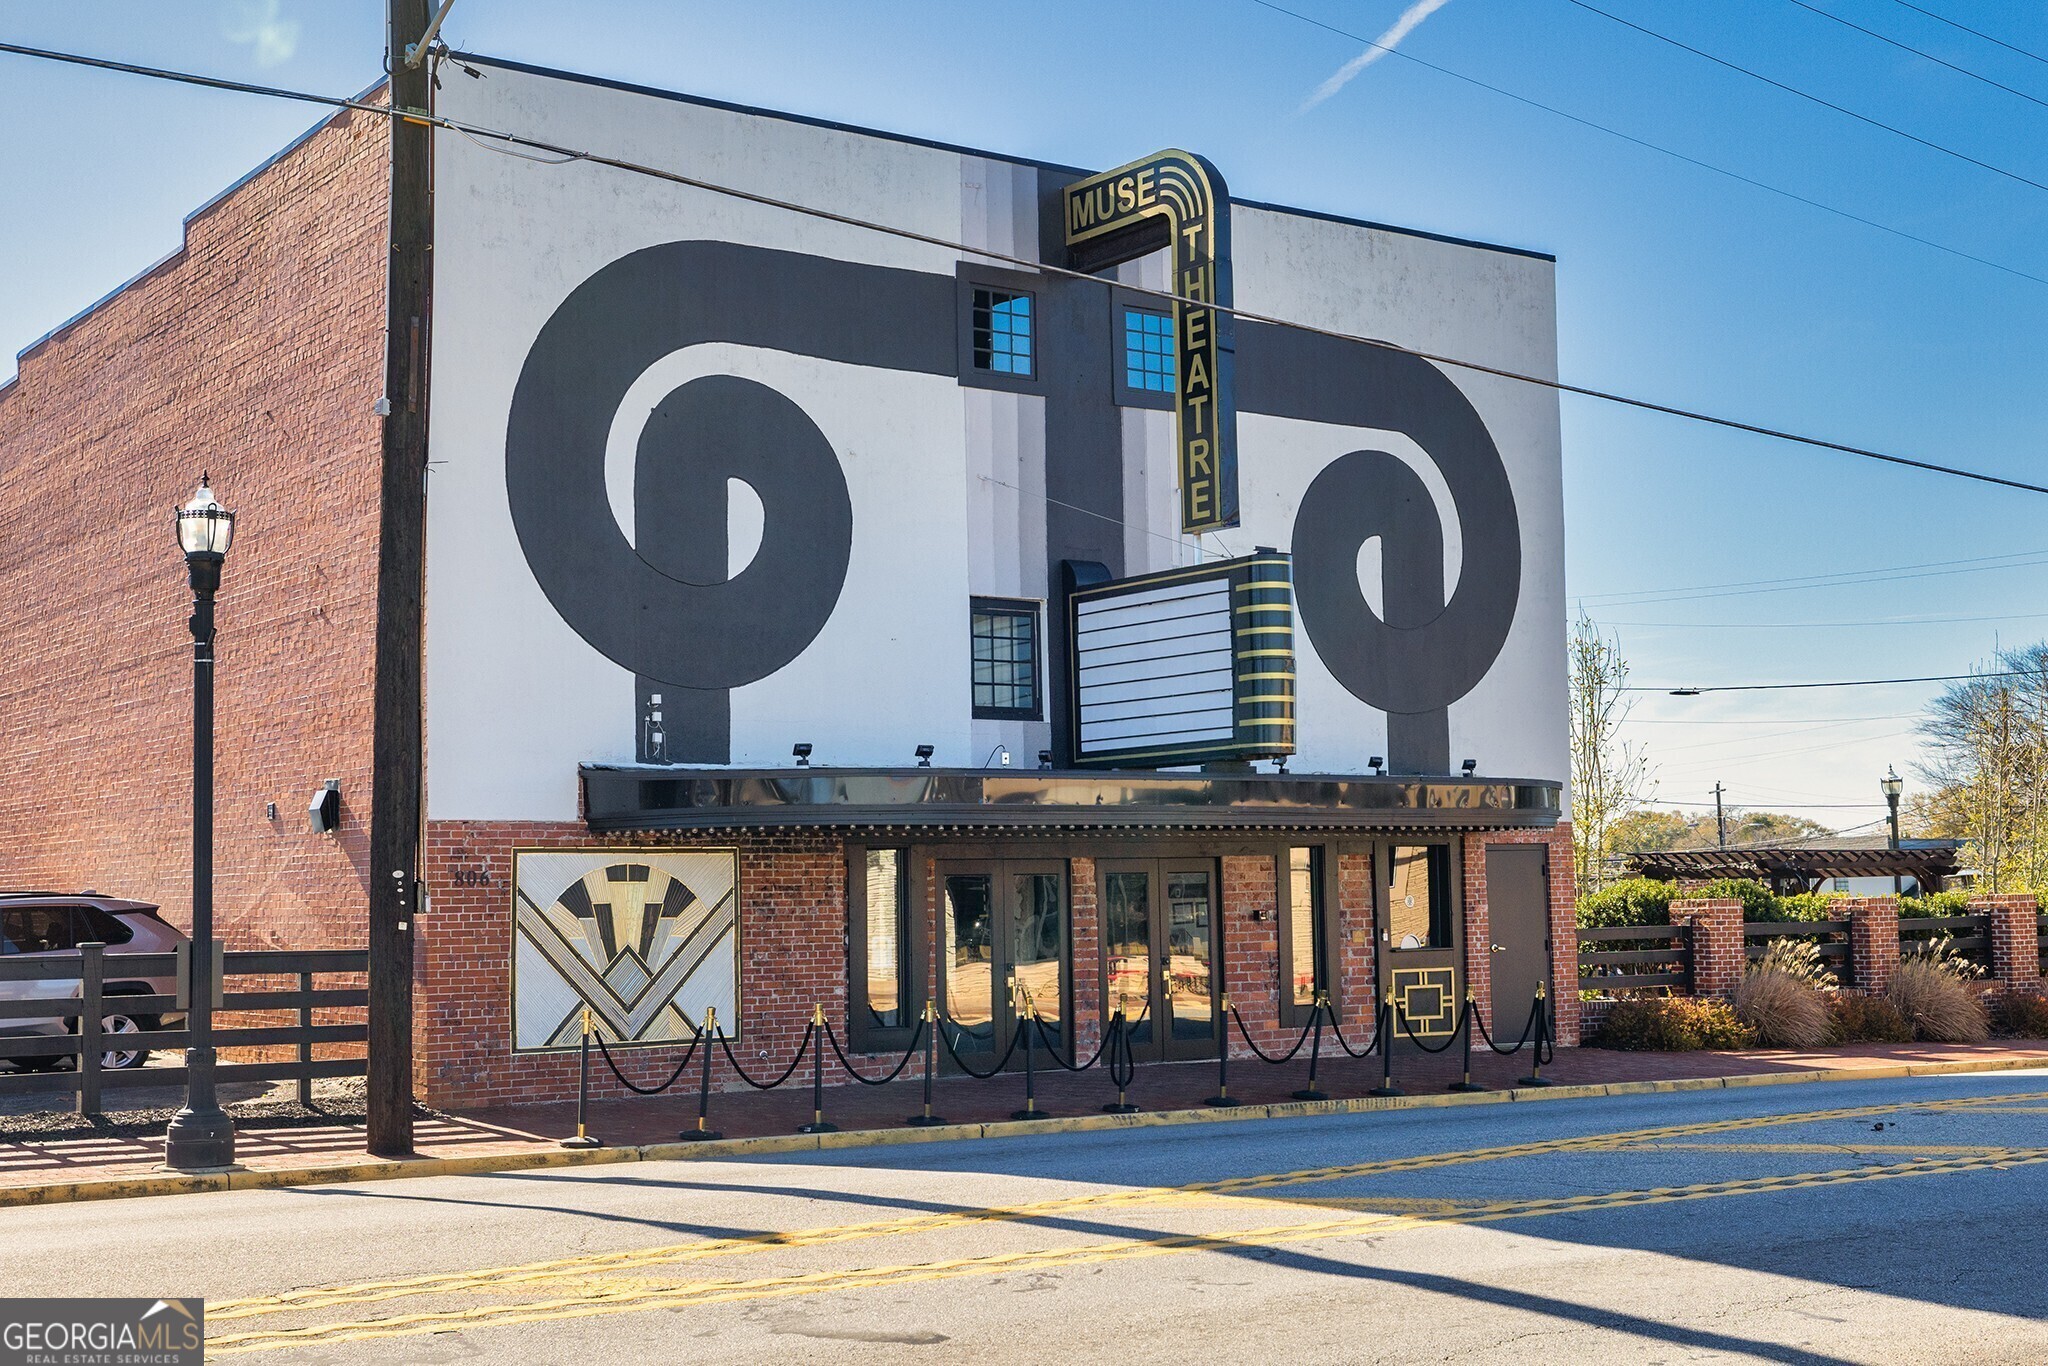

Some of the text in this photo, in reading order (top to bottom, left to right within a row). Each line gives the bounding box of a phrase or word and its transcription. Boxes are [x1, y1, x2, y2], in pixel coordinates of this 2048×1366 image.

[1072, 167, 1156, 230] MUSE
[1182, 223, 1210, 519] THEATRE
[454, 870, 490, 887] 806
